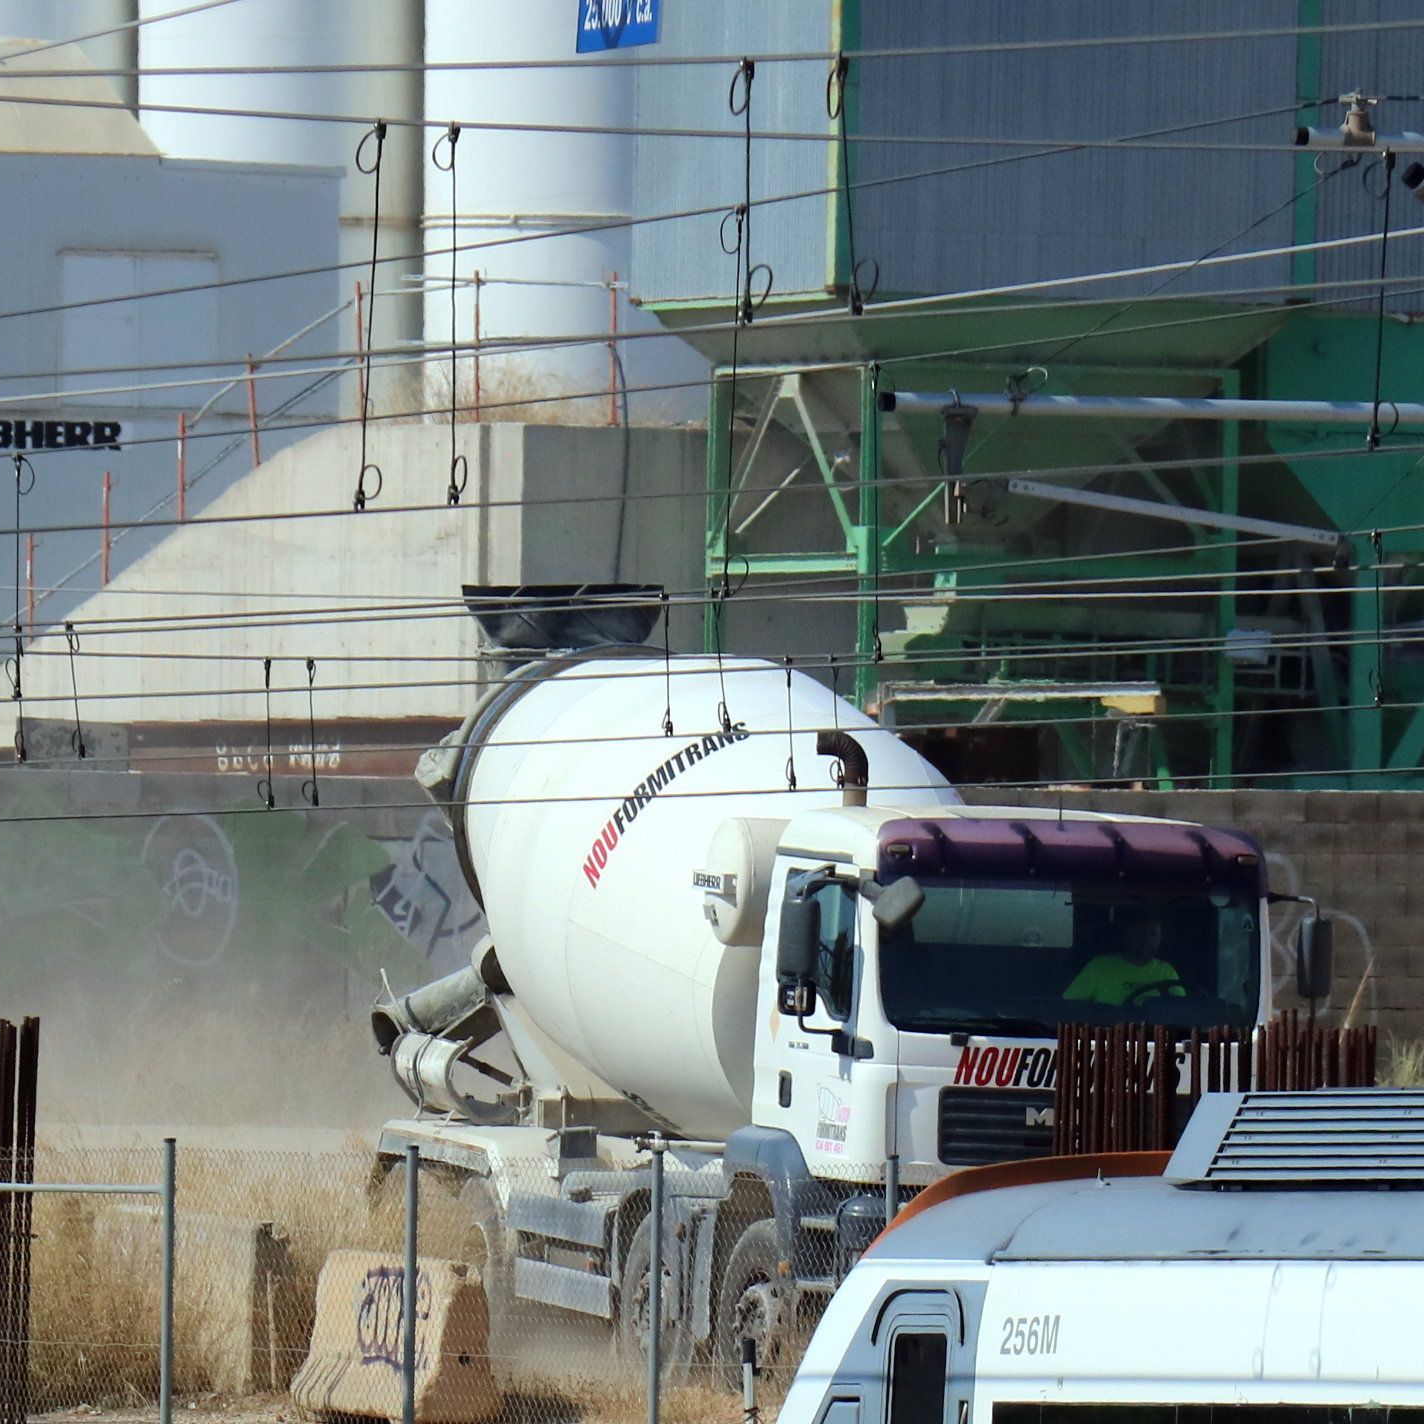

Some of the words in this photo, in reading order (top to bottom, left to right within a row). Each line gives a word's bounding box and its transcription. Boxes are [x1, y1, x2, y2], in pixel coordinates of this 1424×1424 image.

[583, 722, 750, 889] NOUFORMITRANS
[693, 871, 721, 890] LIEBHERR
[999, 1314, 1061, 1355] 256M
